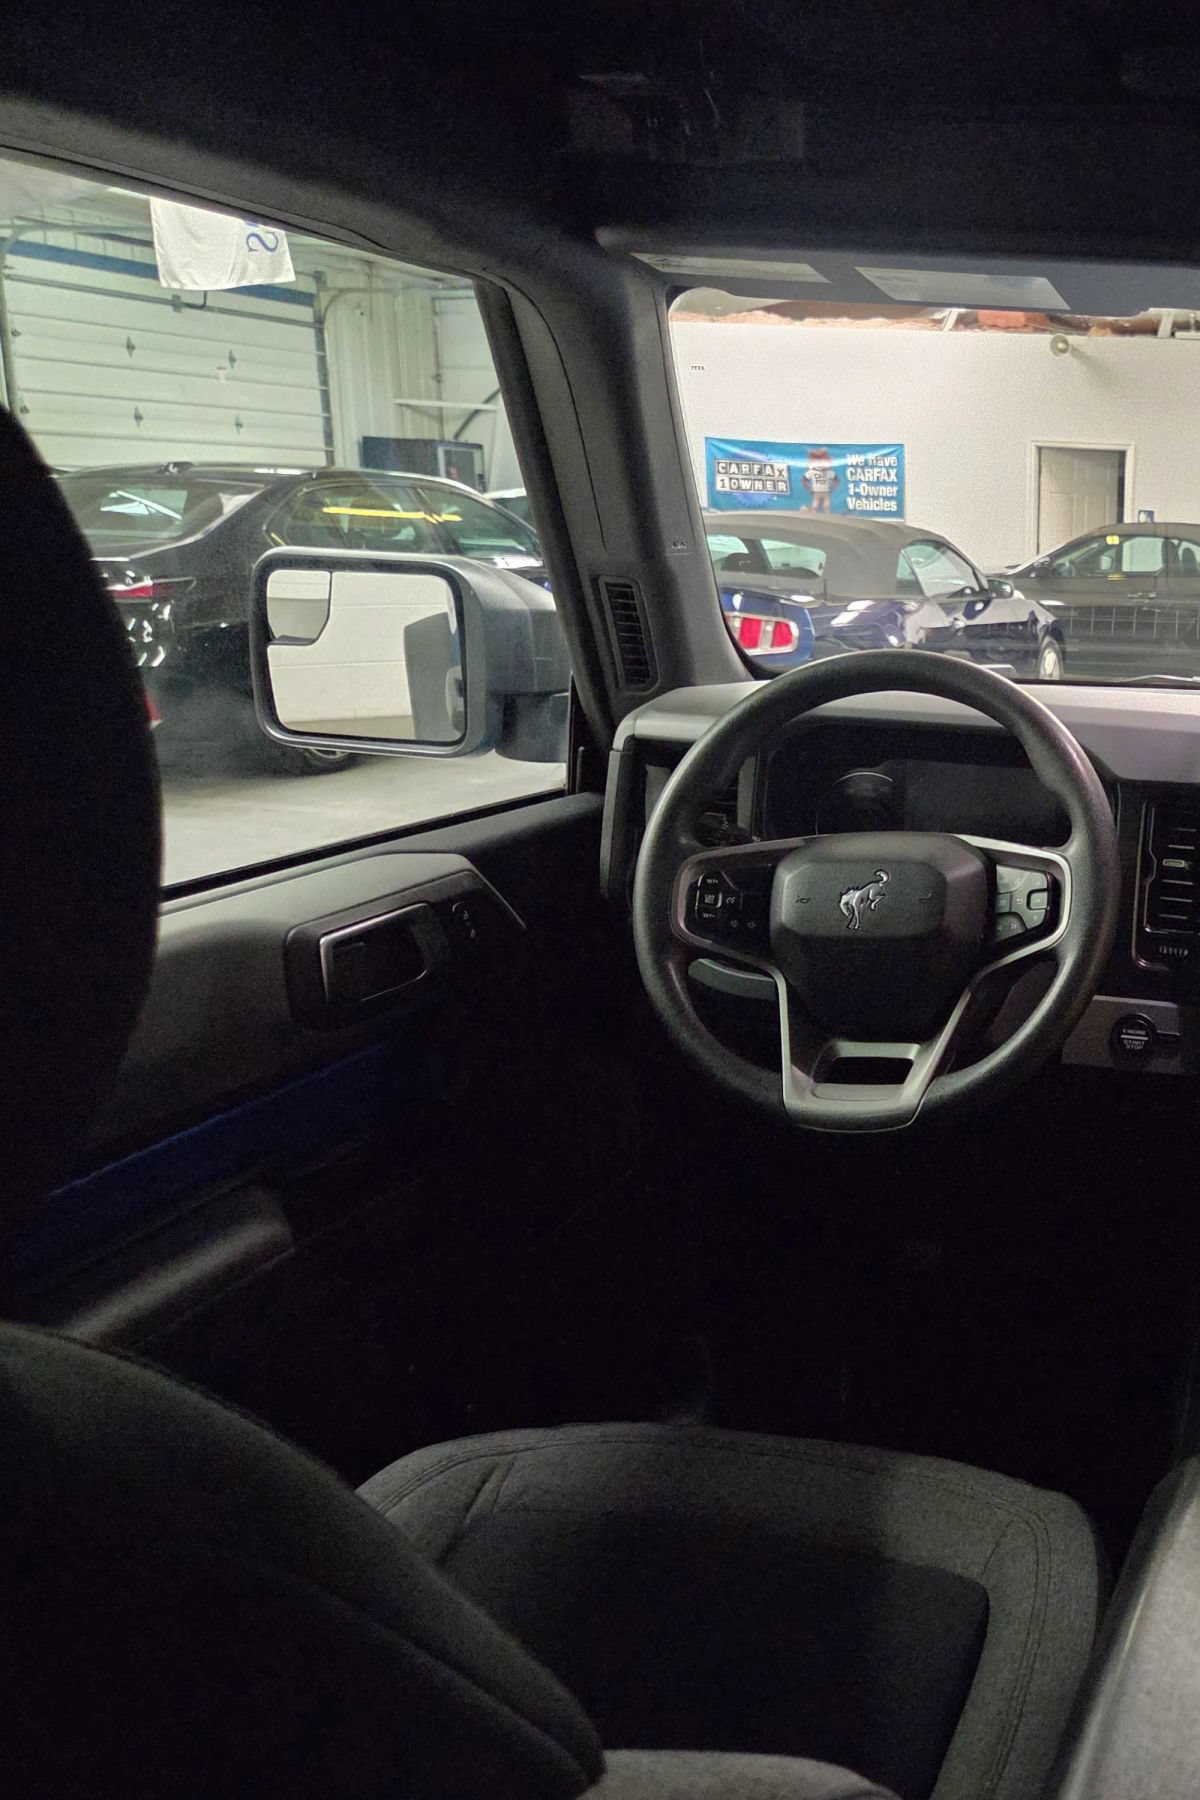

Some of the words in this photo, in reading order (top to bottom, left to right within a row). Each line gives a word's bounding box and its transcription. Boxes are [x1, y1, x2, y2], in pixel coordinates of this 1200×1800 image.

[846, 454, 865, 466] We
[717, 462, 786, 478] CARFAX
[847, 468, 898, 482] CARFAX
[848, 483, 898, 497] 1-Owner
[846, 497, 898, 512] Vehicles
